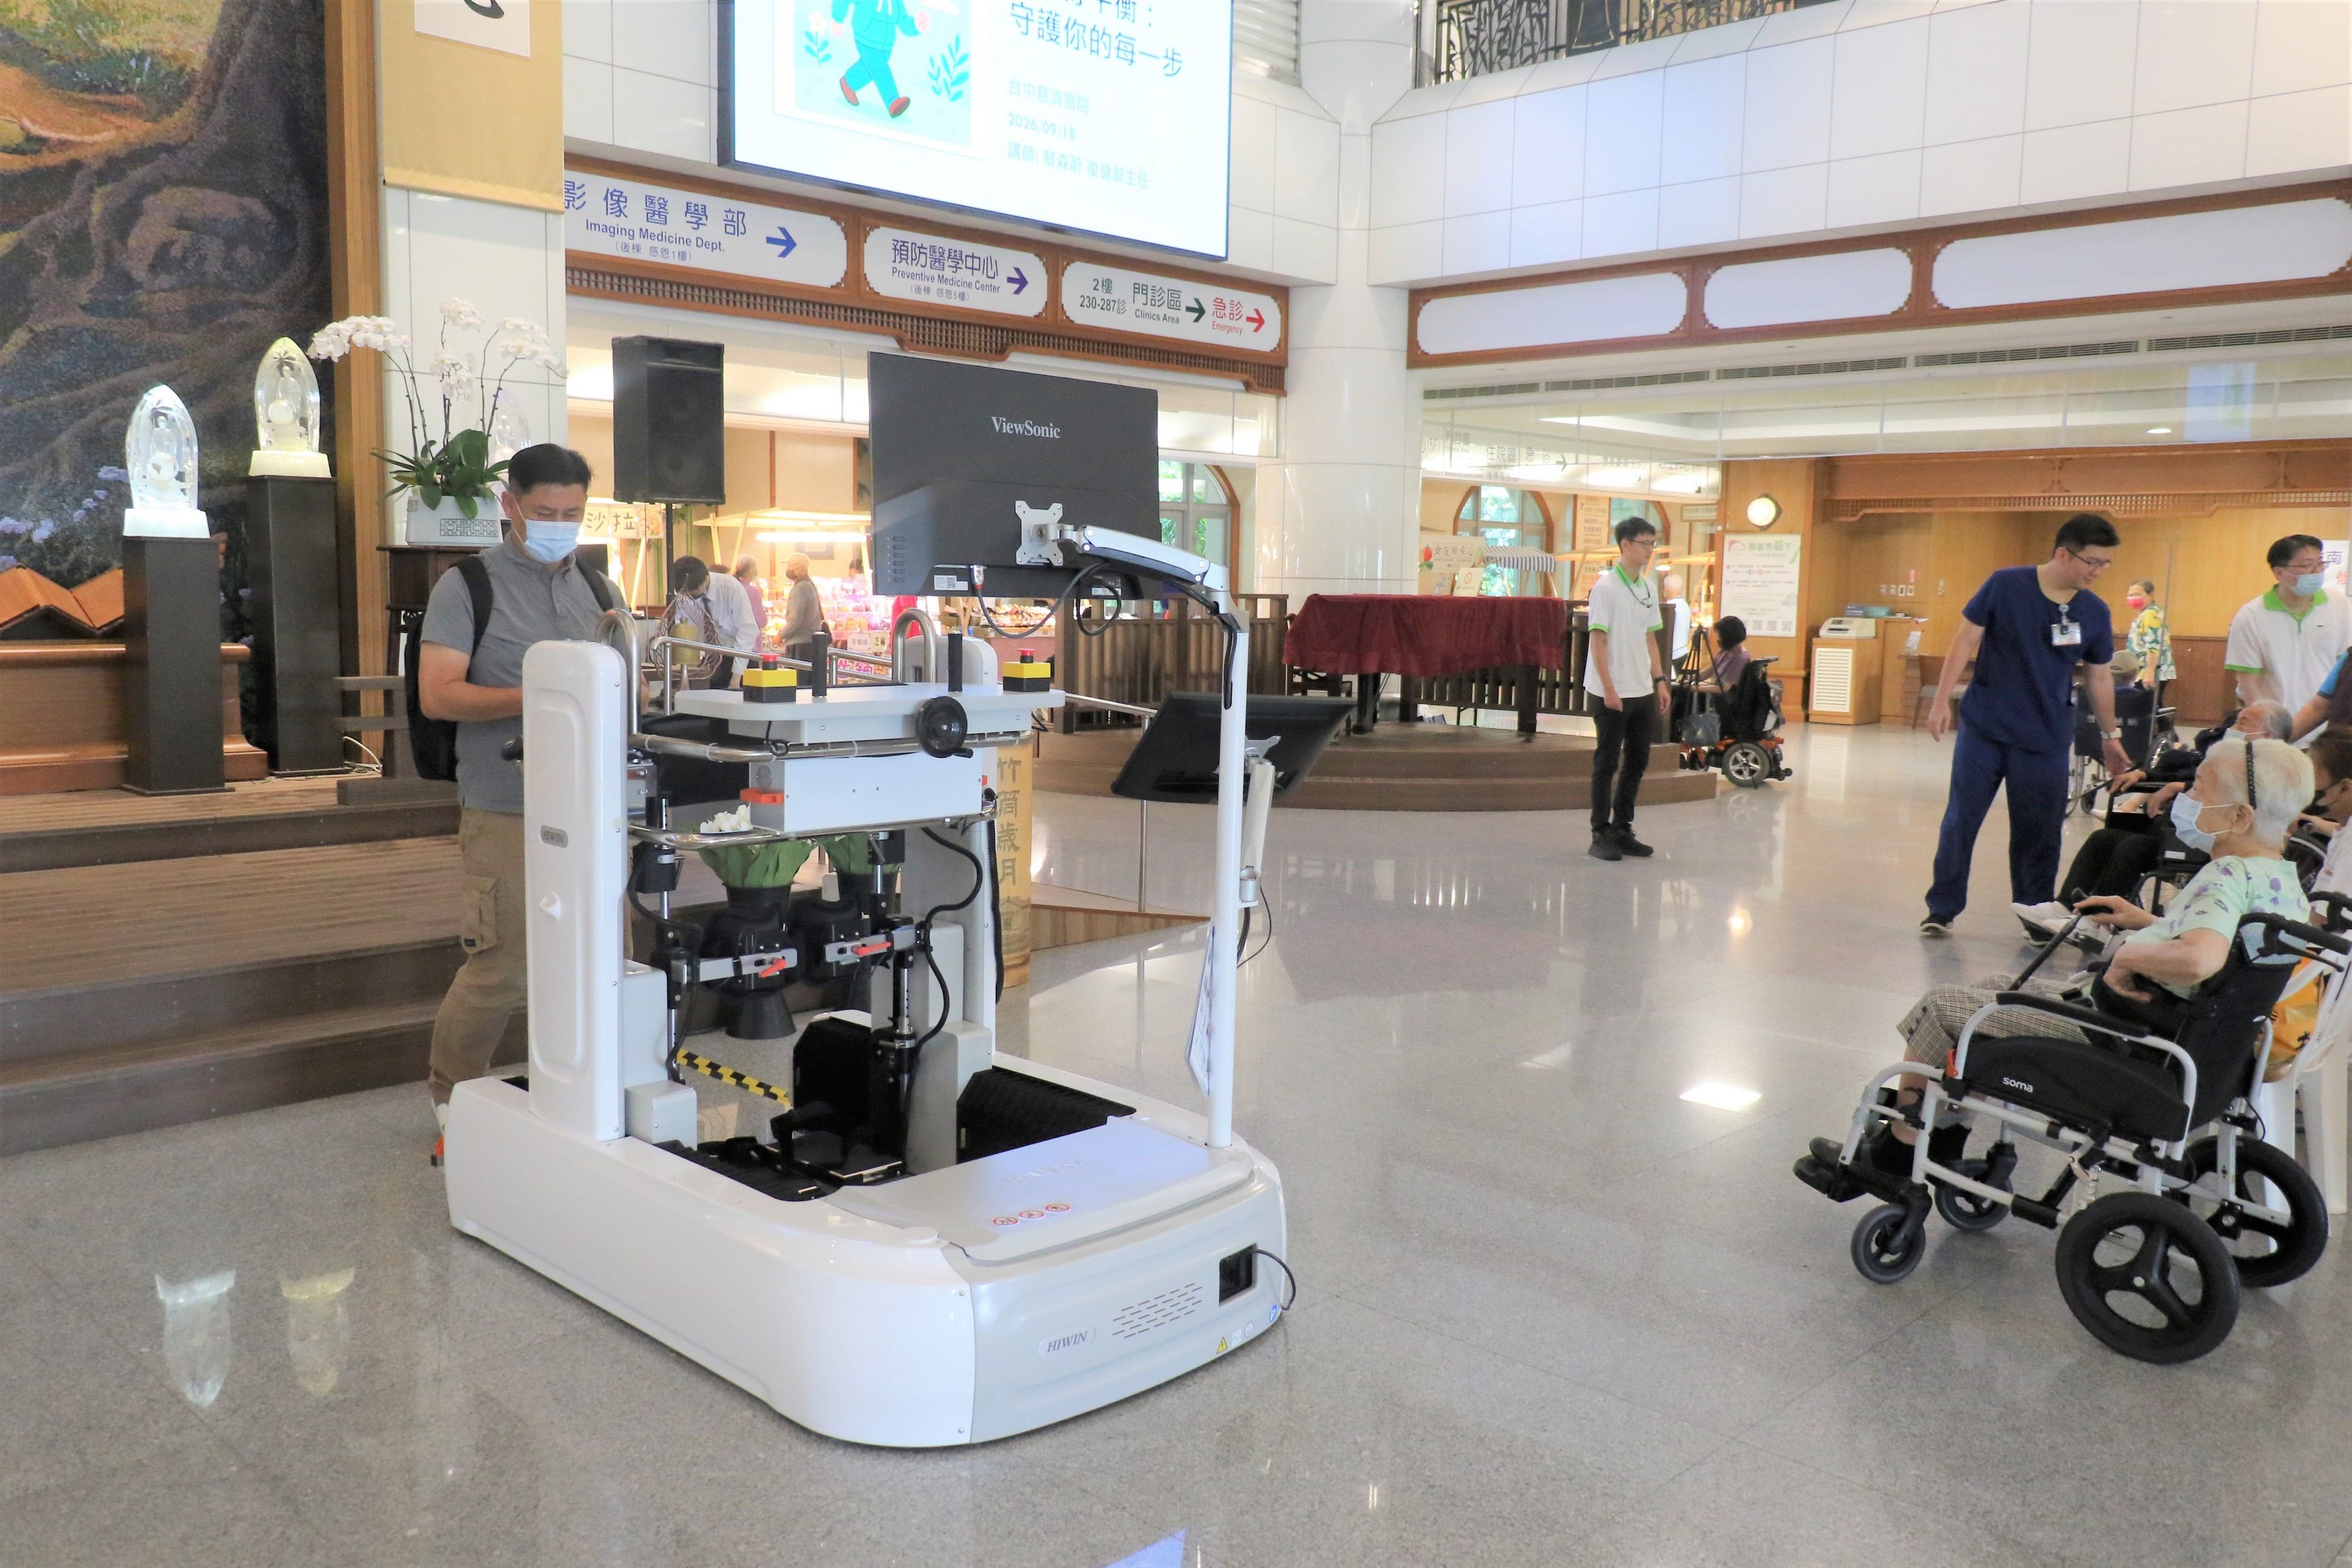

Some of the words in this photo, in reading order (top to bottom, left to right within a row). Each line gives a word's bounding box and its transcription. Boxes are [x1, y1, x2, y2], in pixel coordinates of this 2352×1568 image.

[1010, 1, 1183, 77] 守護你的每一步
[1008, 77, 1090, 114] 台中慈濟醫院
[1008, 113, 1076, 140] 2026/09/18
[564, 180, 746, 237] 影像醫學部
[586, 218, 635, 240] Imaging
[639, 227, 692, 246] Medicine
[696, 237, 725, 252] Dept.
[892, 239, 998, 279] 預防醫學中心
[892, 267, 935, 283] Preventive
[938, 274, 972, 289] Medicine
[975, 280, 1001, 293] Center
[1093, 277, 1112, 295] 2樓
[1080, 295, 1126, 315] 230-287診
[1133, 282, 1181, 311] 門診區
[1212, 296, 1243, 321] 急診
[1135, 309, 1160, 322] Clinics
[1162, 311, 1180, 324] Area
[1211, 320, 1243, 336] Emergency
[991, 416, 1060, 439] ViewSonic
[1486, 445, 1517, 463] 住院區
[586, 511, 635, 532] 沙拉
[2003, 1077, 2033, 1093] soma
[1047, 1330, 1088, 1353] HIWIN
